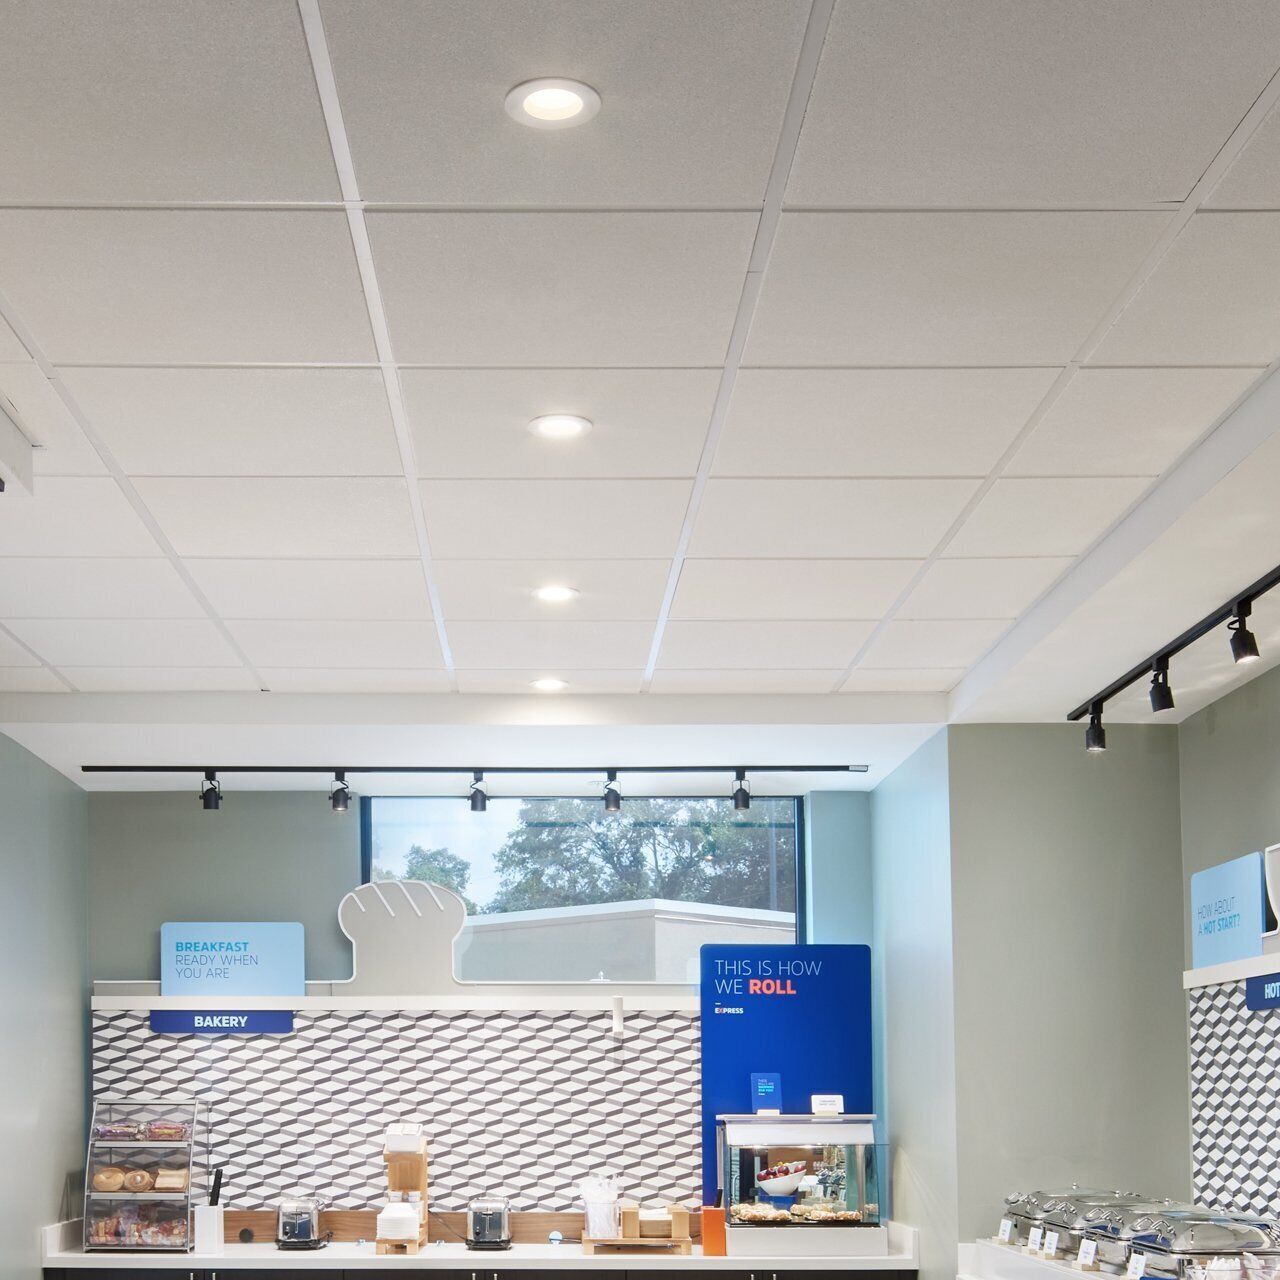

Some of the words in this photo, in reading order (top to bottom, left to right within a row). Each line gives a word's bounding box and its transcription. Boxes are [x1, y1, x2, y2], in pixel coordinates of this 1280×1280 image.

[1197, 902, 1213, 920] HOW
[1214, 896, 1236, 915] ABOUT
[1204, 920, 1216, 935] HOT
[175, 941, 249, 952] BREAKFAST
[175, 954, 216, 966] READY
[220, 954, 259, 966] WHEN
[175, 967, 201, 979] YOU
[205, 967, 230, 979] ARE
[714, 960, 752, 976] THIS
[758, 960, 773, 976] IS
[778, 960, 822, 976] HOW
[714, 978, 743, 995] WE
[748, 978, 797, 995] ROLL
[1264, 981, 1280, 999] HOT
[194, 1015, 248, 1028] BAKERY
